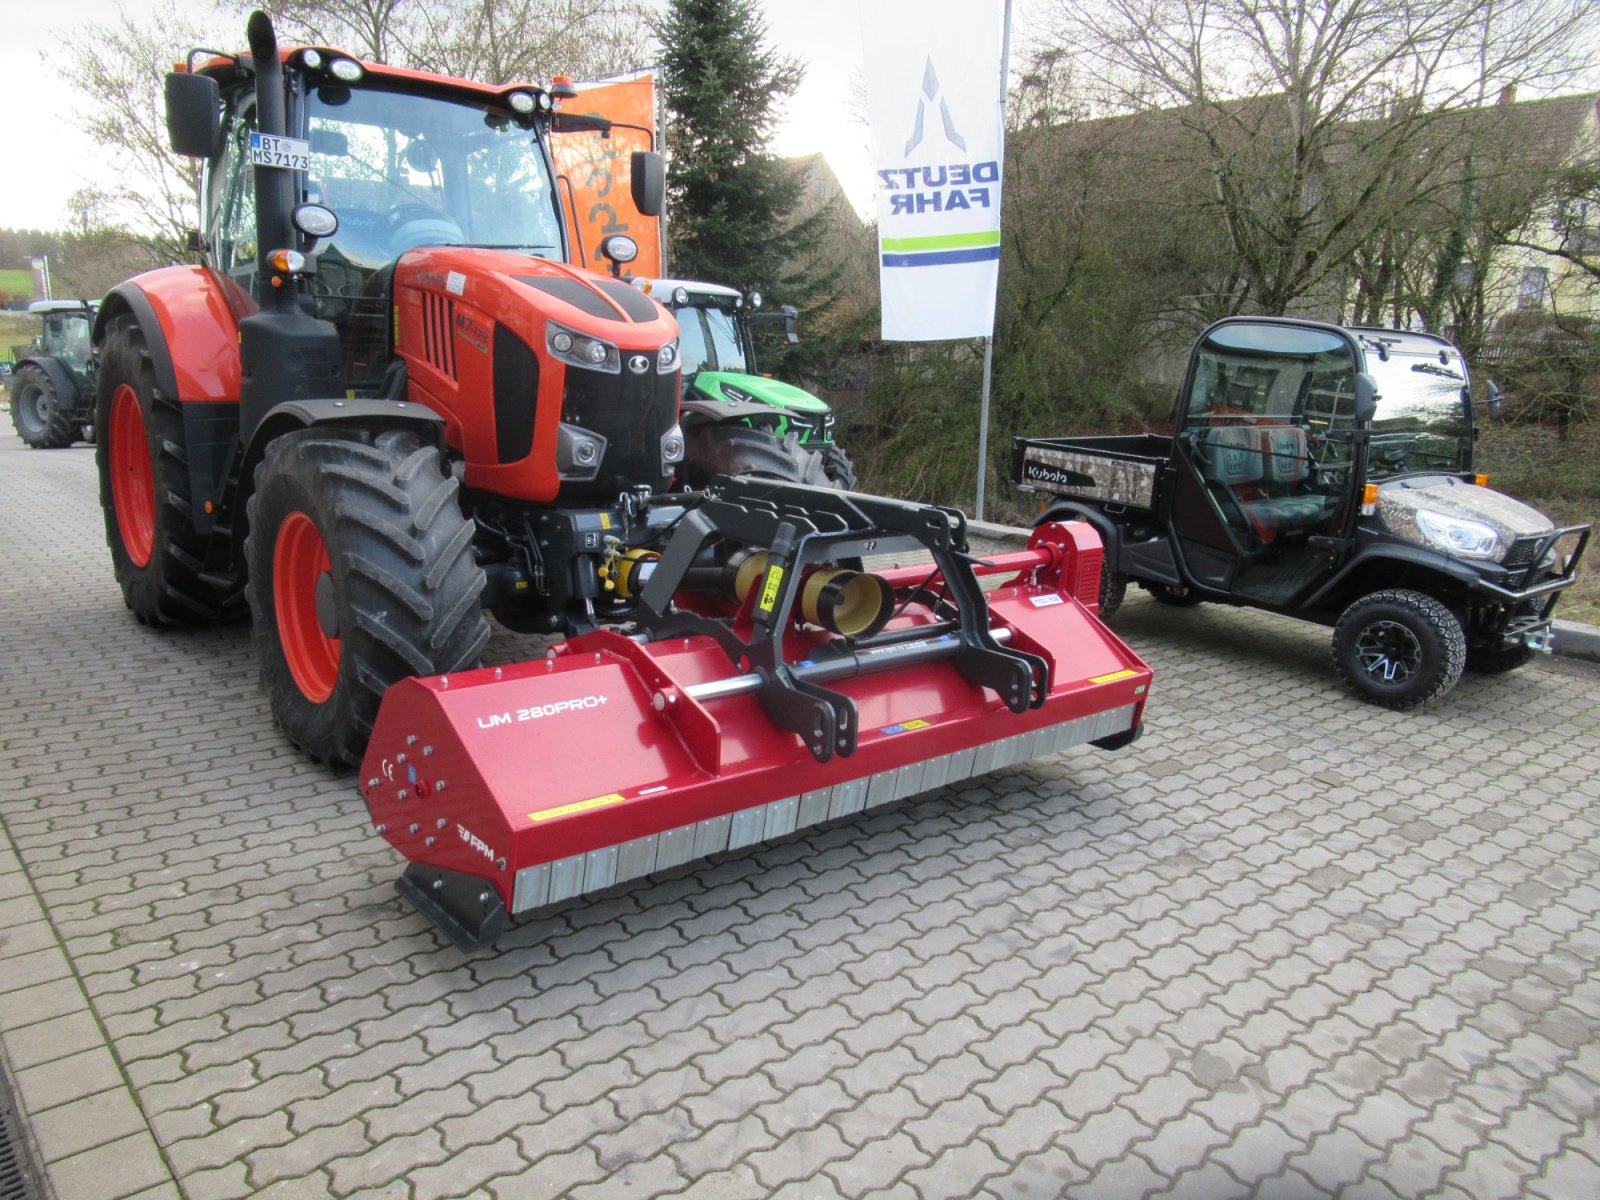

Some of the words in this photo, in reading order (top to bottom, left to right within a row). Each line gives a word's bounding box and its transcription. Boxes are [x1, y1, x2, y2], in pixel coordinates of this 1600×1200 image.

[262, 137, 280, 151] BT
[253, 149, 272, 164] MS
[274, 152, 308, 169] 7173
[1028, 465, 1067, 483] Kubota
[477, 712, 512, 728] UM
[516, 695, 608, 721] 280PRO+
[470, 834, 495, 862] FPM
